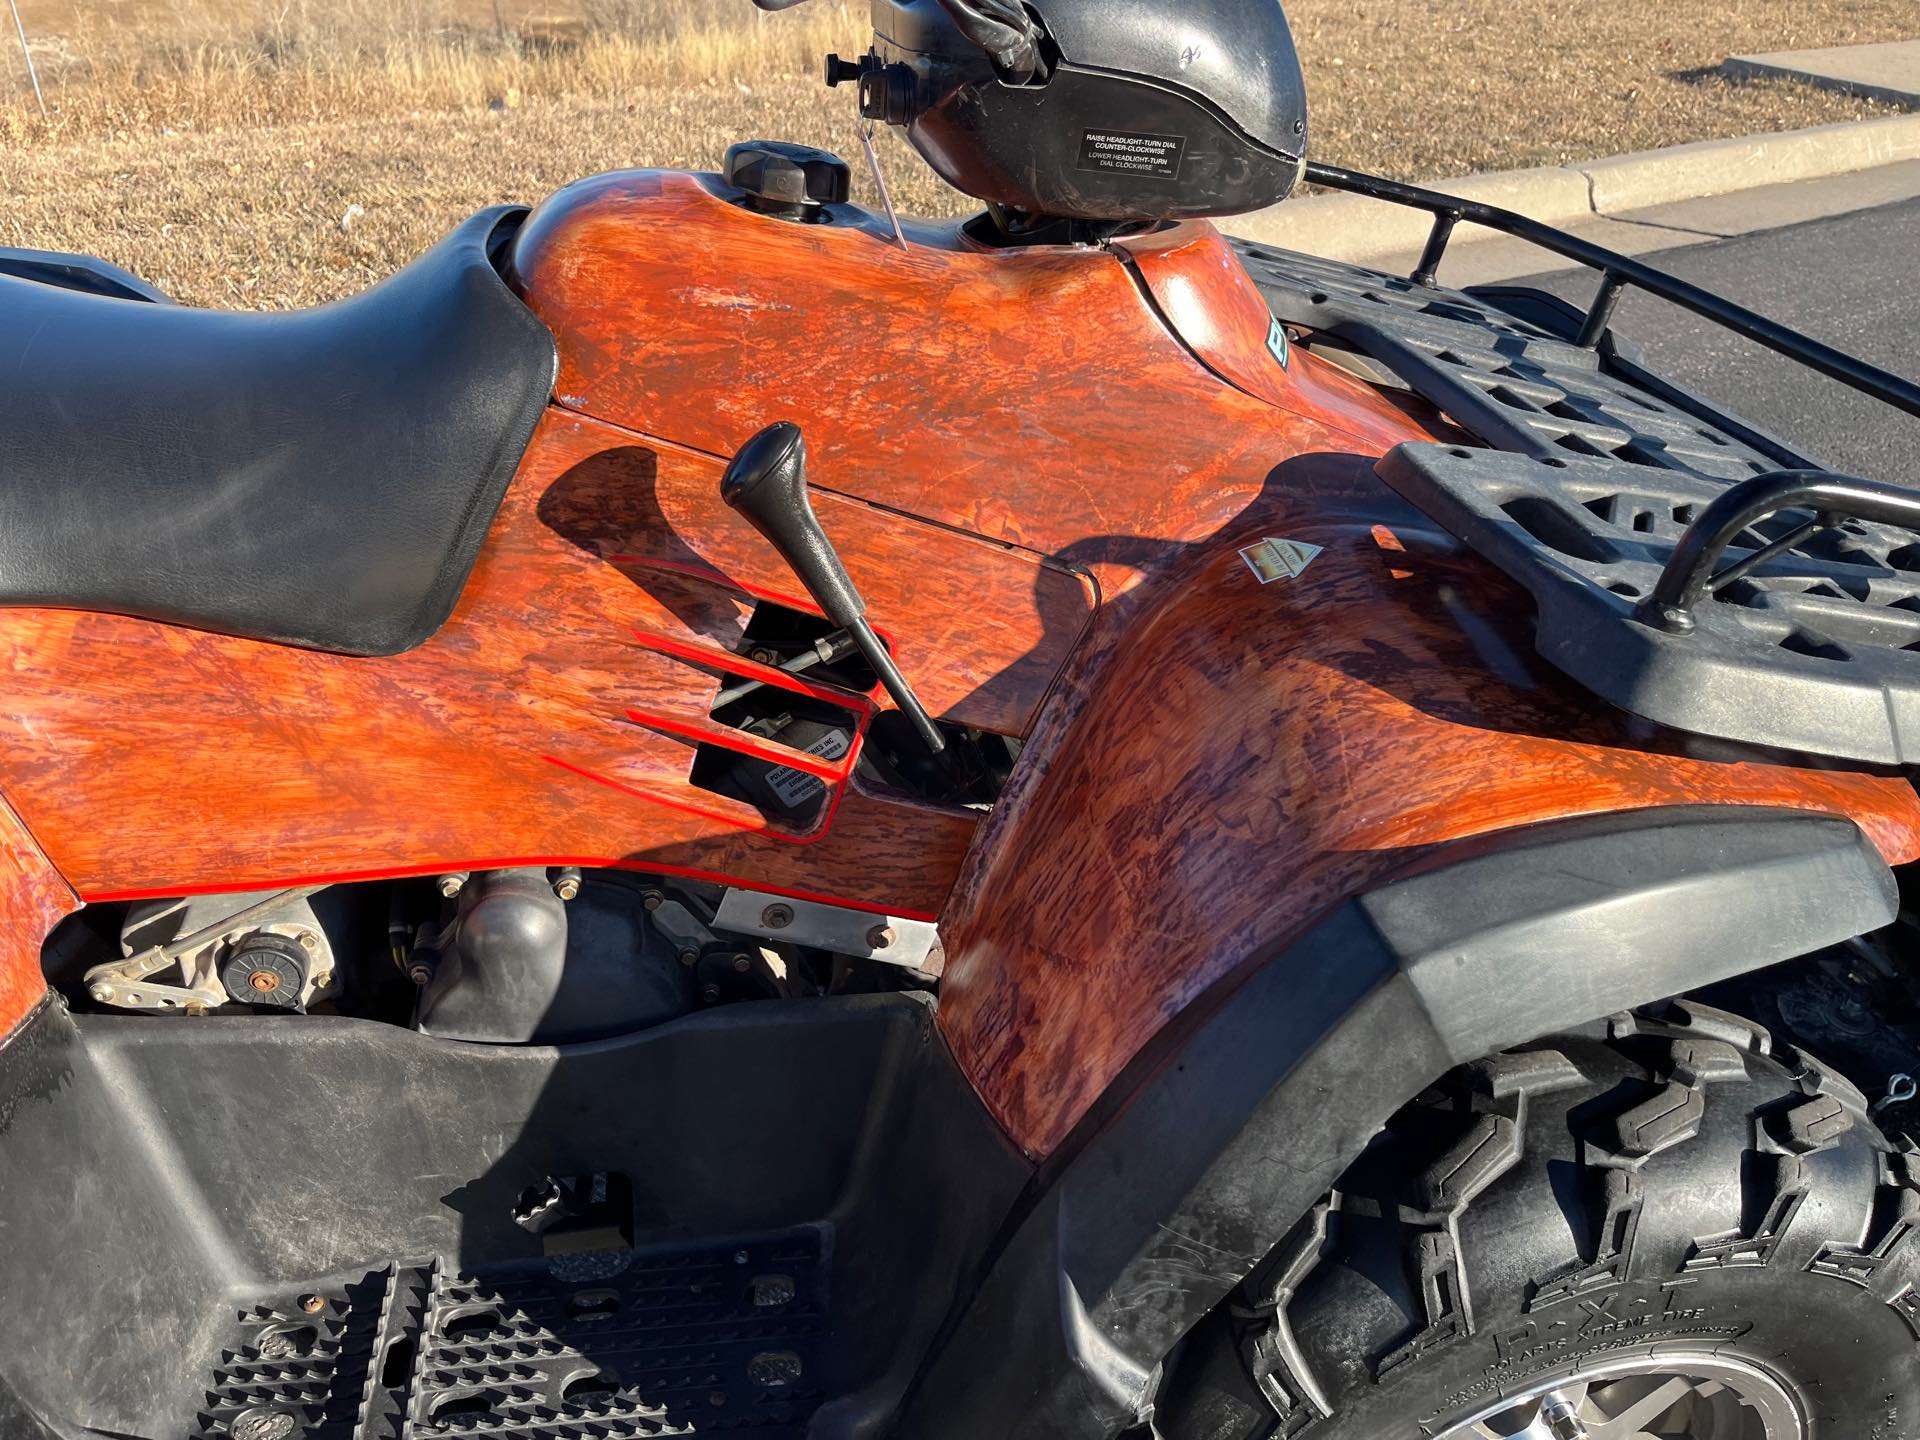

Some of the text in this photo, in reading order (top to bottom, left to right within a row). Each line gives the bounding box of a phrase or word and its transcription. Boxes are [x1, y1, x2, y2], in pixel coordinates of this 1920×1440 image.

[1086, 134, 1176, 149] RAISE HEADLIGHT-TURN DIAL
[1095, 142, 1166, 155] COUNTER-CLOCKWISE
[1088, 152, 1168, 165] LOWER HEADLIGHT-TURN
[1115, 160, 1154, 171] CLOCKWISE
[823, 737, 834, 748] INC
[1577, 1313, 1653, 1344] XTREME
[1662, 1307, 1706, 1323] TIRE
